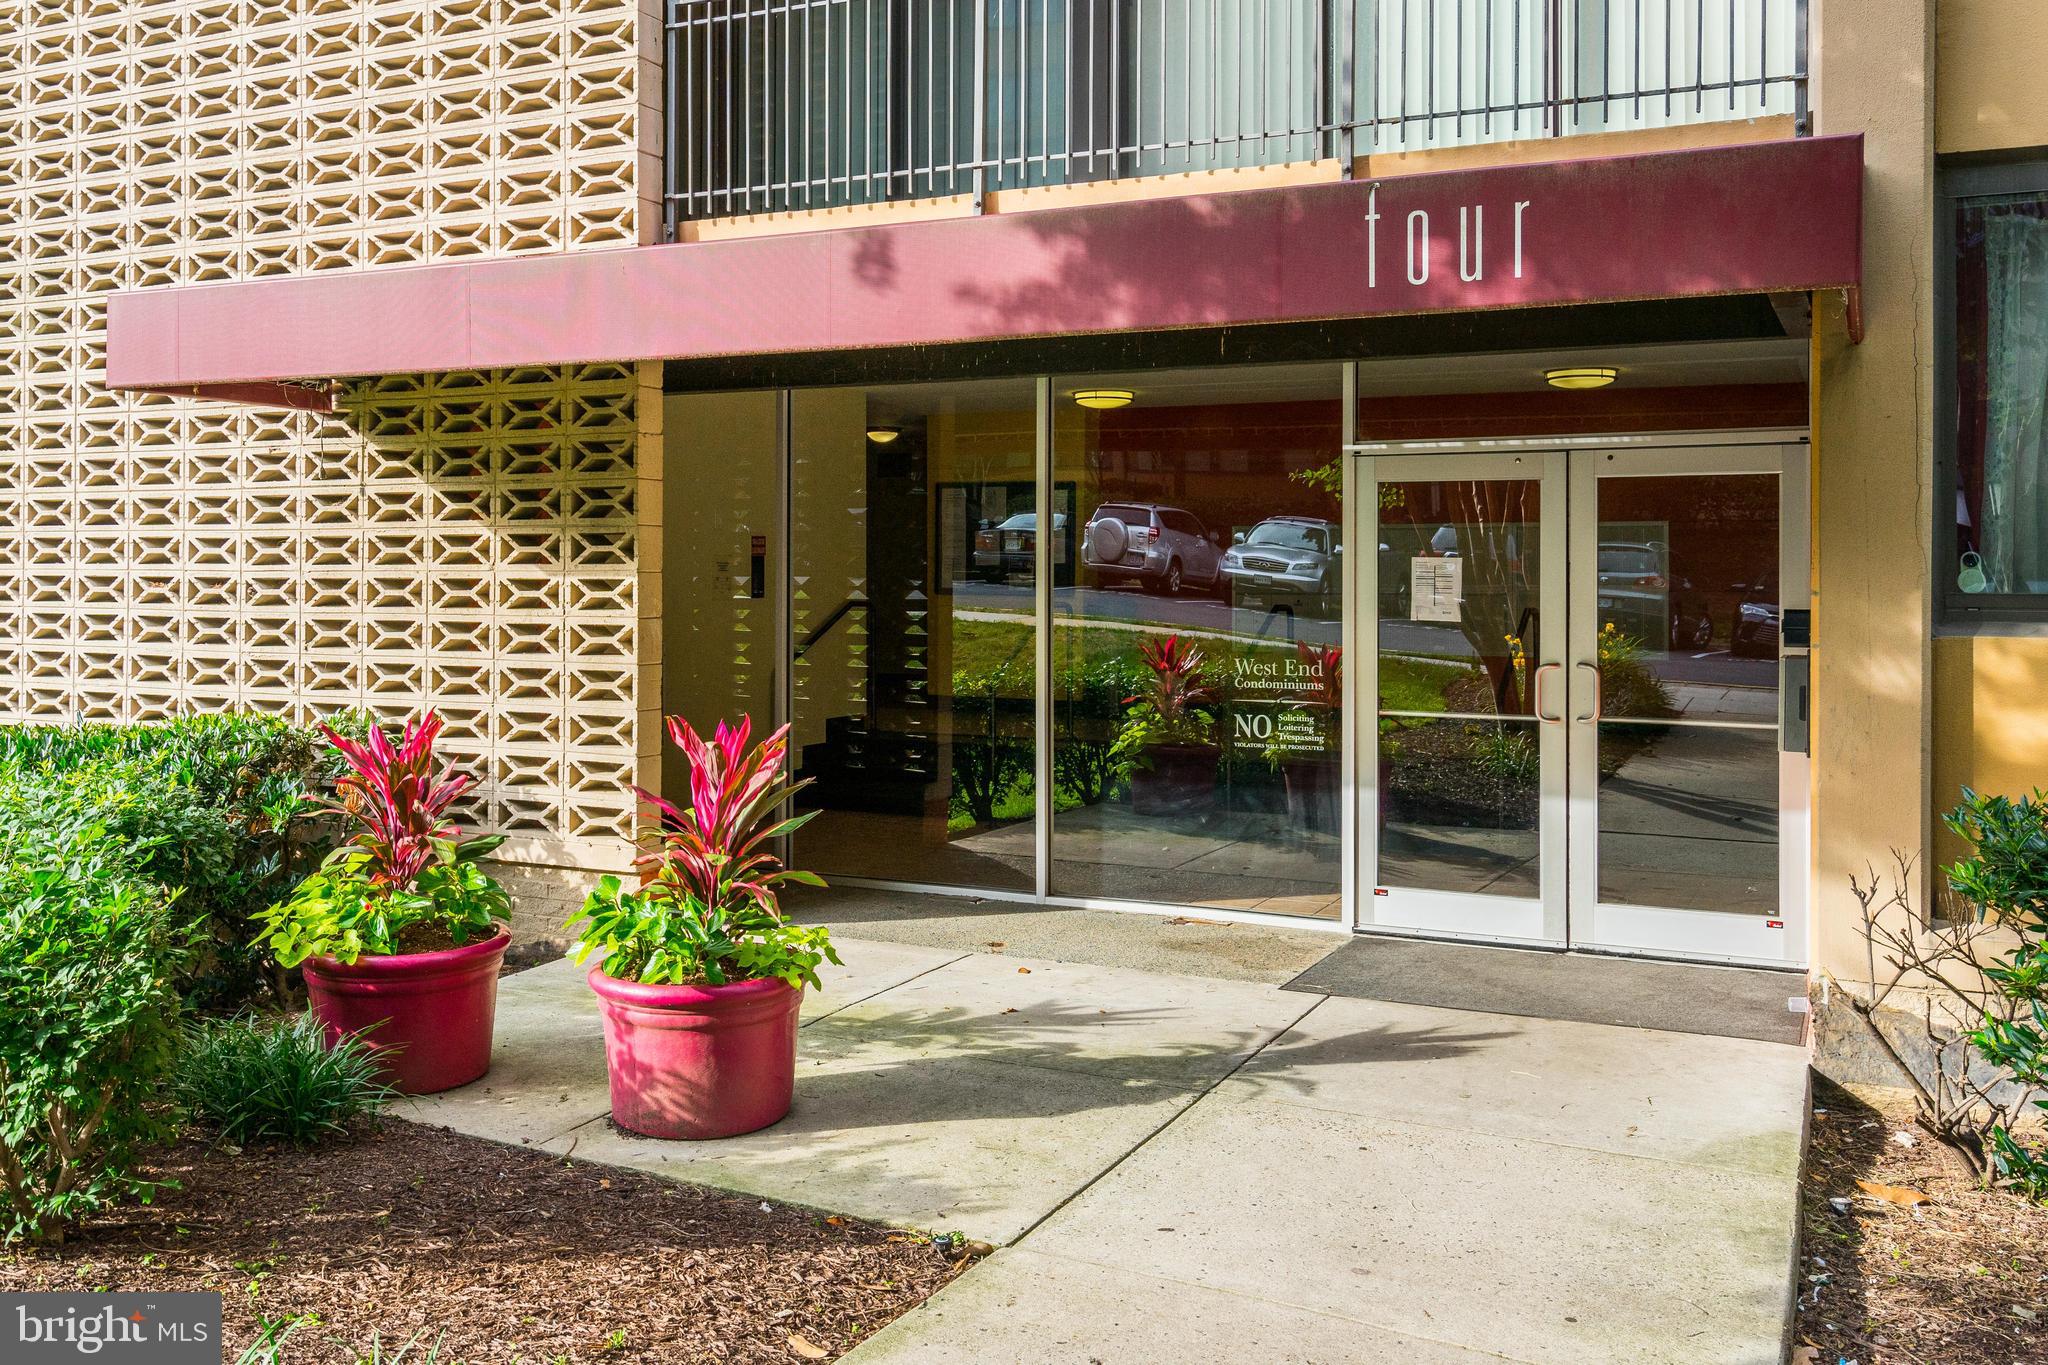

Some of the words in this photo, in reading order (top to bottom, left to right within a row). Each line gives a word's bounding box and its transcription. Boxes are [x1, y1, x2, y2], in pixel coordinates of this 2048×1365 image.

[1365, 182, 1530, 288] four
[1234, 658, 1278, 677] West
[1284, 659, 1324, 677] End
[1234, 677, 1325, 690] Condominiums
[1278, 713, 1315, 724] Soliciting
[1234, 713, 1272, 739] NO
[1278, 723, 1315, 734] Loitering
[1278, 732, 1325, 744] Trespassing
